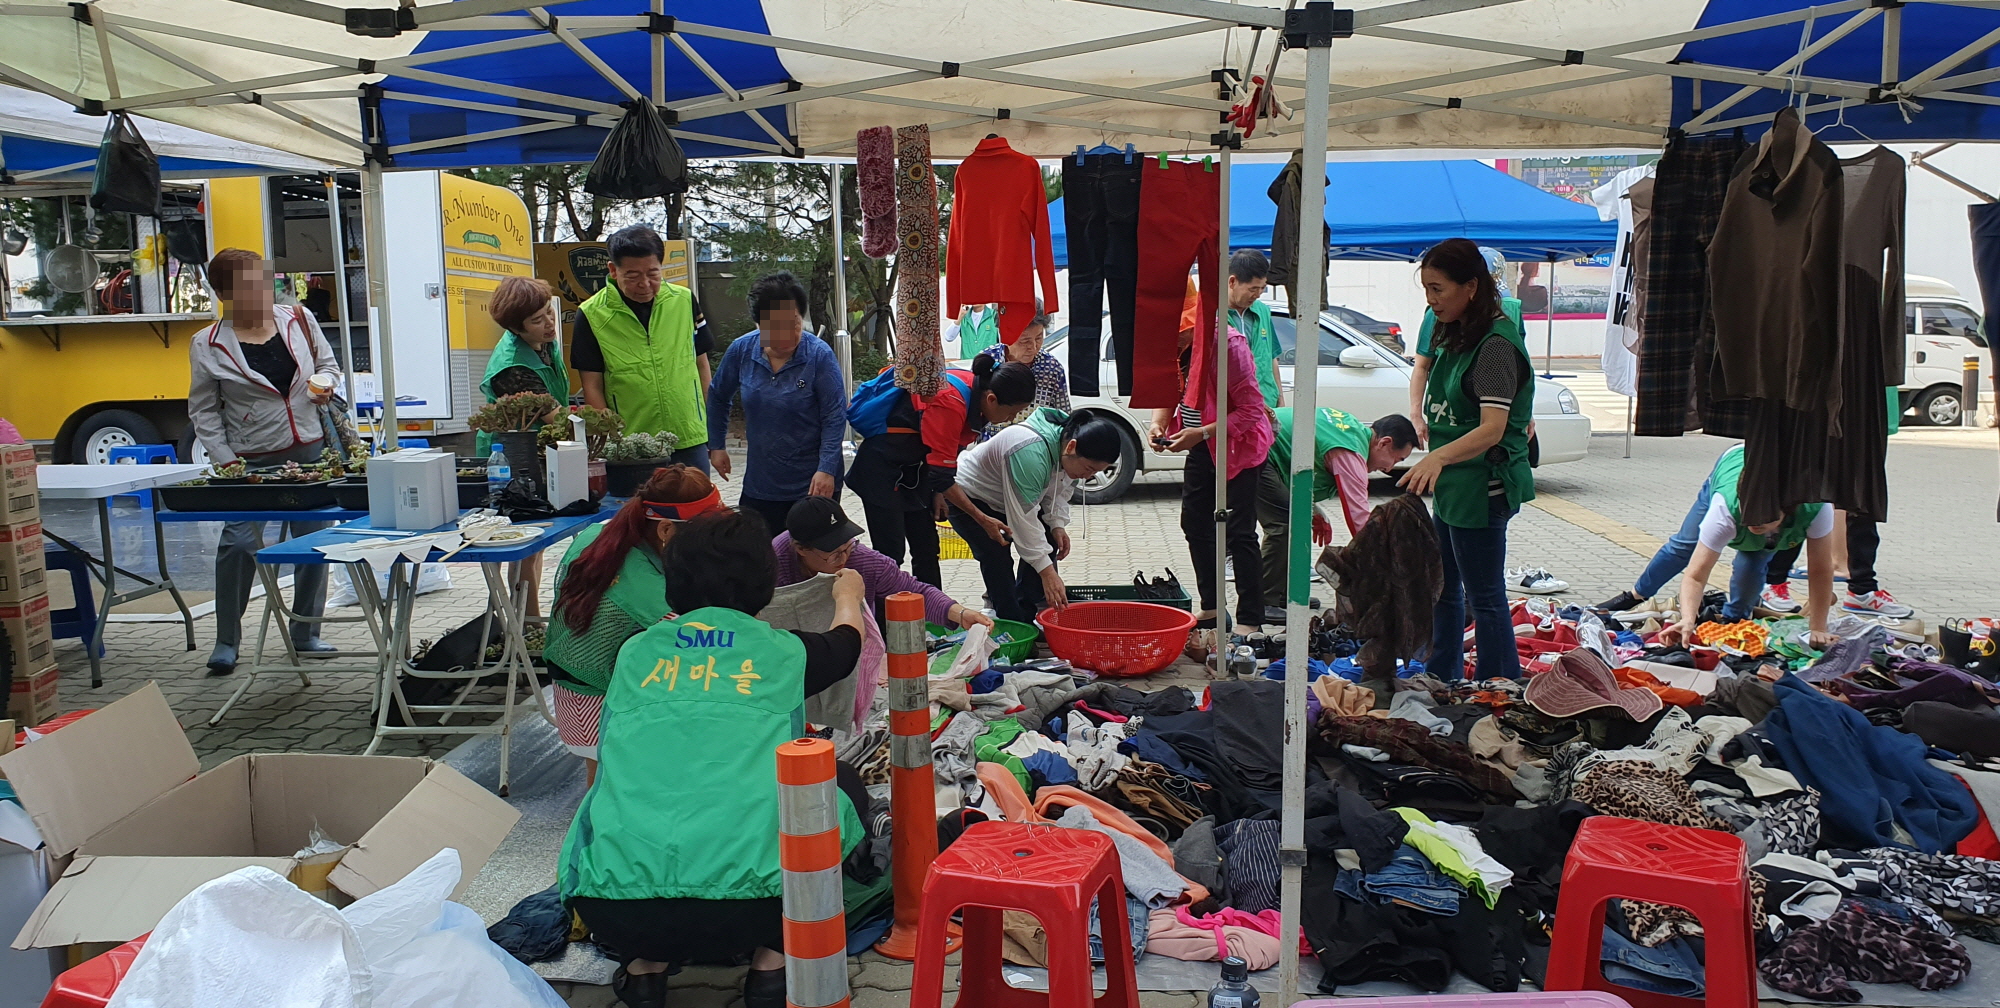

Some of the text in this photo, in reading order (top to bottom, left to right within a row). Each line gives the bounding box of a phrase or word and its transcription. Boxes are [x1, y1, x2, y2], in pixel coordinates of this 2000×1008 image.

[452, 190, 500, 223] Number
[504, 213, 524, 247] One
[452, 257, 513, 274] ALL CUSTOM TRAILERS
[1428, 394, 1458, 426] 마을
[675, 625, 736, 649] SMU
[640, 655, 762, 695] 새마을
